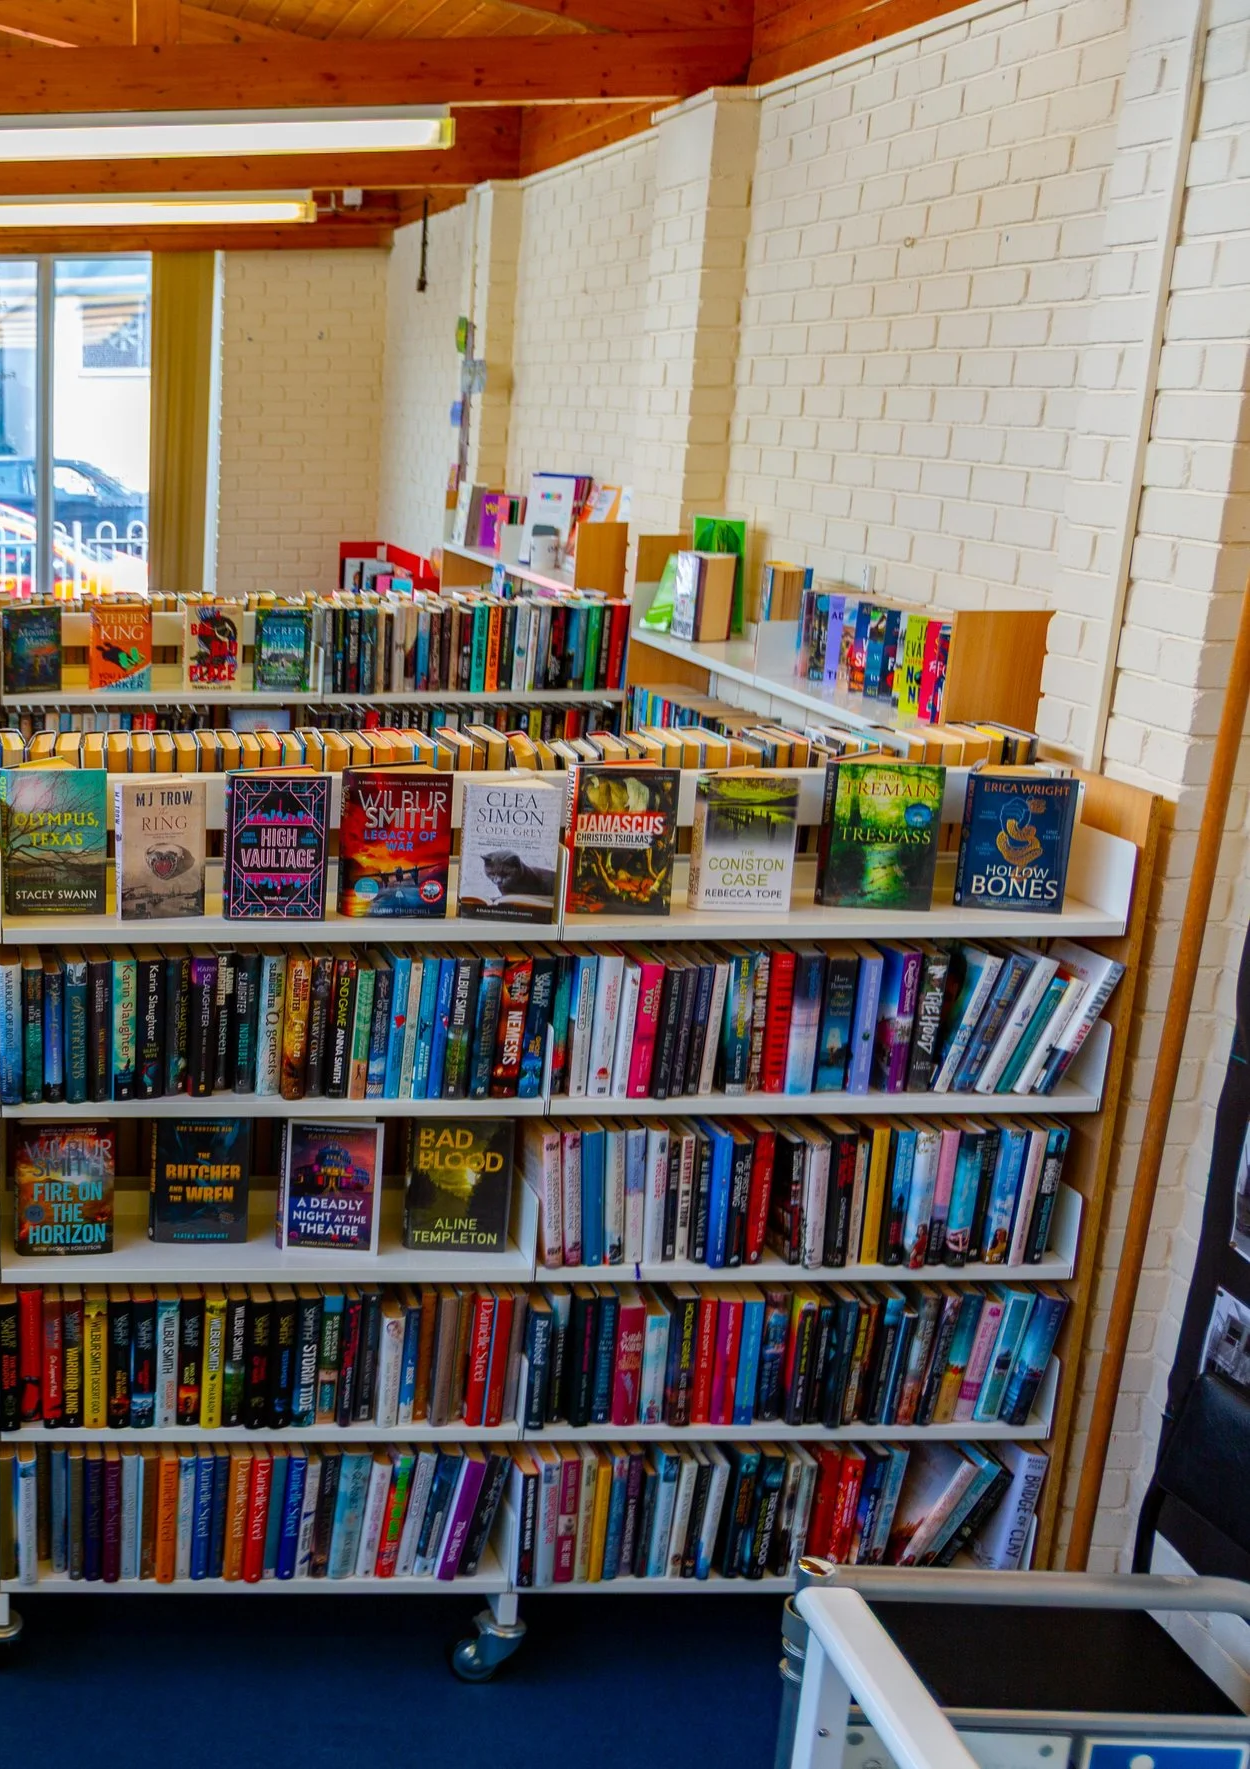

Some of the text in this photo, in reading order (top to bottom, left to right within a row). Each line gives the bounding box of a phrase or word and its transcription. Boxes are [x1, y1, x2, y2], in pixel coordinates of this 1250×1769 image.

[95, 613, 149, 624] STEPHEN
[100, 625, 144, 640] KING
[262, 626, 305, 636] SECRETS
[100, 680, 143, 689] DARKER
[878, 773, 902, 782] ROSE
[160, 790, 193, 806] TROW
[844, 781, 937, 799] TREMAIN
[984, 781, 1070, 797] ERICA WRIGHT
[358, 789, 447, 813] WILBUR
[486, 791, 538, 809] CLEA
[565, 769, 576, 836] DAMASCUS
[14, 812, 99, 828] OLYMPUS,
[142, 815, 188, 831] RING
[365, 807, 437, 829] SMITH
[477, 807, 545, 826] SIMON
[577, 814, 664, 835] DAMASCUS
[30, 831, 83, 847] TEXAS
[261, 828, 298, 847] HIGH
[364, 829, 437, 841] LEGACY OF
[576, 833, 650, 844] CHRISTOS TSIOLKAS
[839, 825, 932, 845] TRESPASS
[386, 840, 414, 851] WAR
[240, 848, 316, 868] VAULTAGE
[708, 857, 785, 872] CONISTON
[721, 872, 769, 887] CASE
[986, 863, 1050, 878] HOLLOW
[15, 889, 97, 900] STACEY SWANN
[704, 888, 782, 899] REBECCA TOPE
[971, 874, 1058, 900] BONES
[216, 956, 227, 1006] SLAUGHTER
[145, 964, 159, 1041] Karin Slaughter
[237, 972, 248, 1017] SLAUGHTER
[119, 964, 133, 1058] Karin Slaughter
[333, 977, 350, 1084] END GAME ANNA SMITH
[916, 988, 943, 1054] THE HOOD
[218, 1009, 229, 1056] unseen
[293, 1018, 305, 1059] fallen
[503, 1010, 523, 1065] NEMESIS
[238, 1023, 250, 1066] INDELIBLE
[267, 1029, 279, 1076] genesis
[418, 1127, 474, 1149] BAD
[418, 1151, 505, 1173] BLOOD
[165, 1163, 242, 1181] BUTCHER
[33, 1181, 103, 1201] FIRE ON
[185, 1185, 235, 1203] WREN
[52, 1203, 84, 1223] THE
[297, 1197, 364, 1211] A DEADLY
[293, 1210, 367, 1225] NIGHT AT THE
[434, 1218, 478, 1231] ALINE
[28, 1223, 107, 1245] HORIZON
[299, 1222, 359, 1237] THEATRE
[412, 1230, 498, 1245] TEMPLETON
[65, 1347, 78, 1415] WARRIOR KING
[299, 1343, 317, 1412] STORM TIDE
[161, 1462, 178, 1543] Danielle Steel
[1017, 1474, 1041, 1514] BRIDGE
[446, 1520, 466, 1563] The Monk
[1006, 1528, 1026, 1558] CLAY
